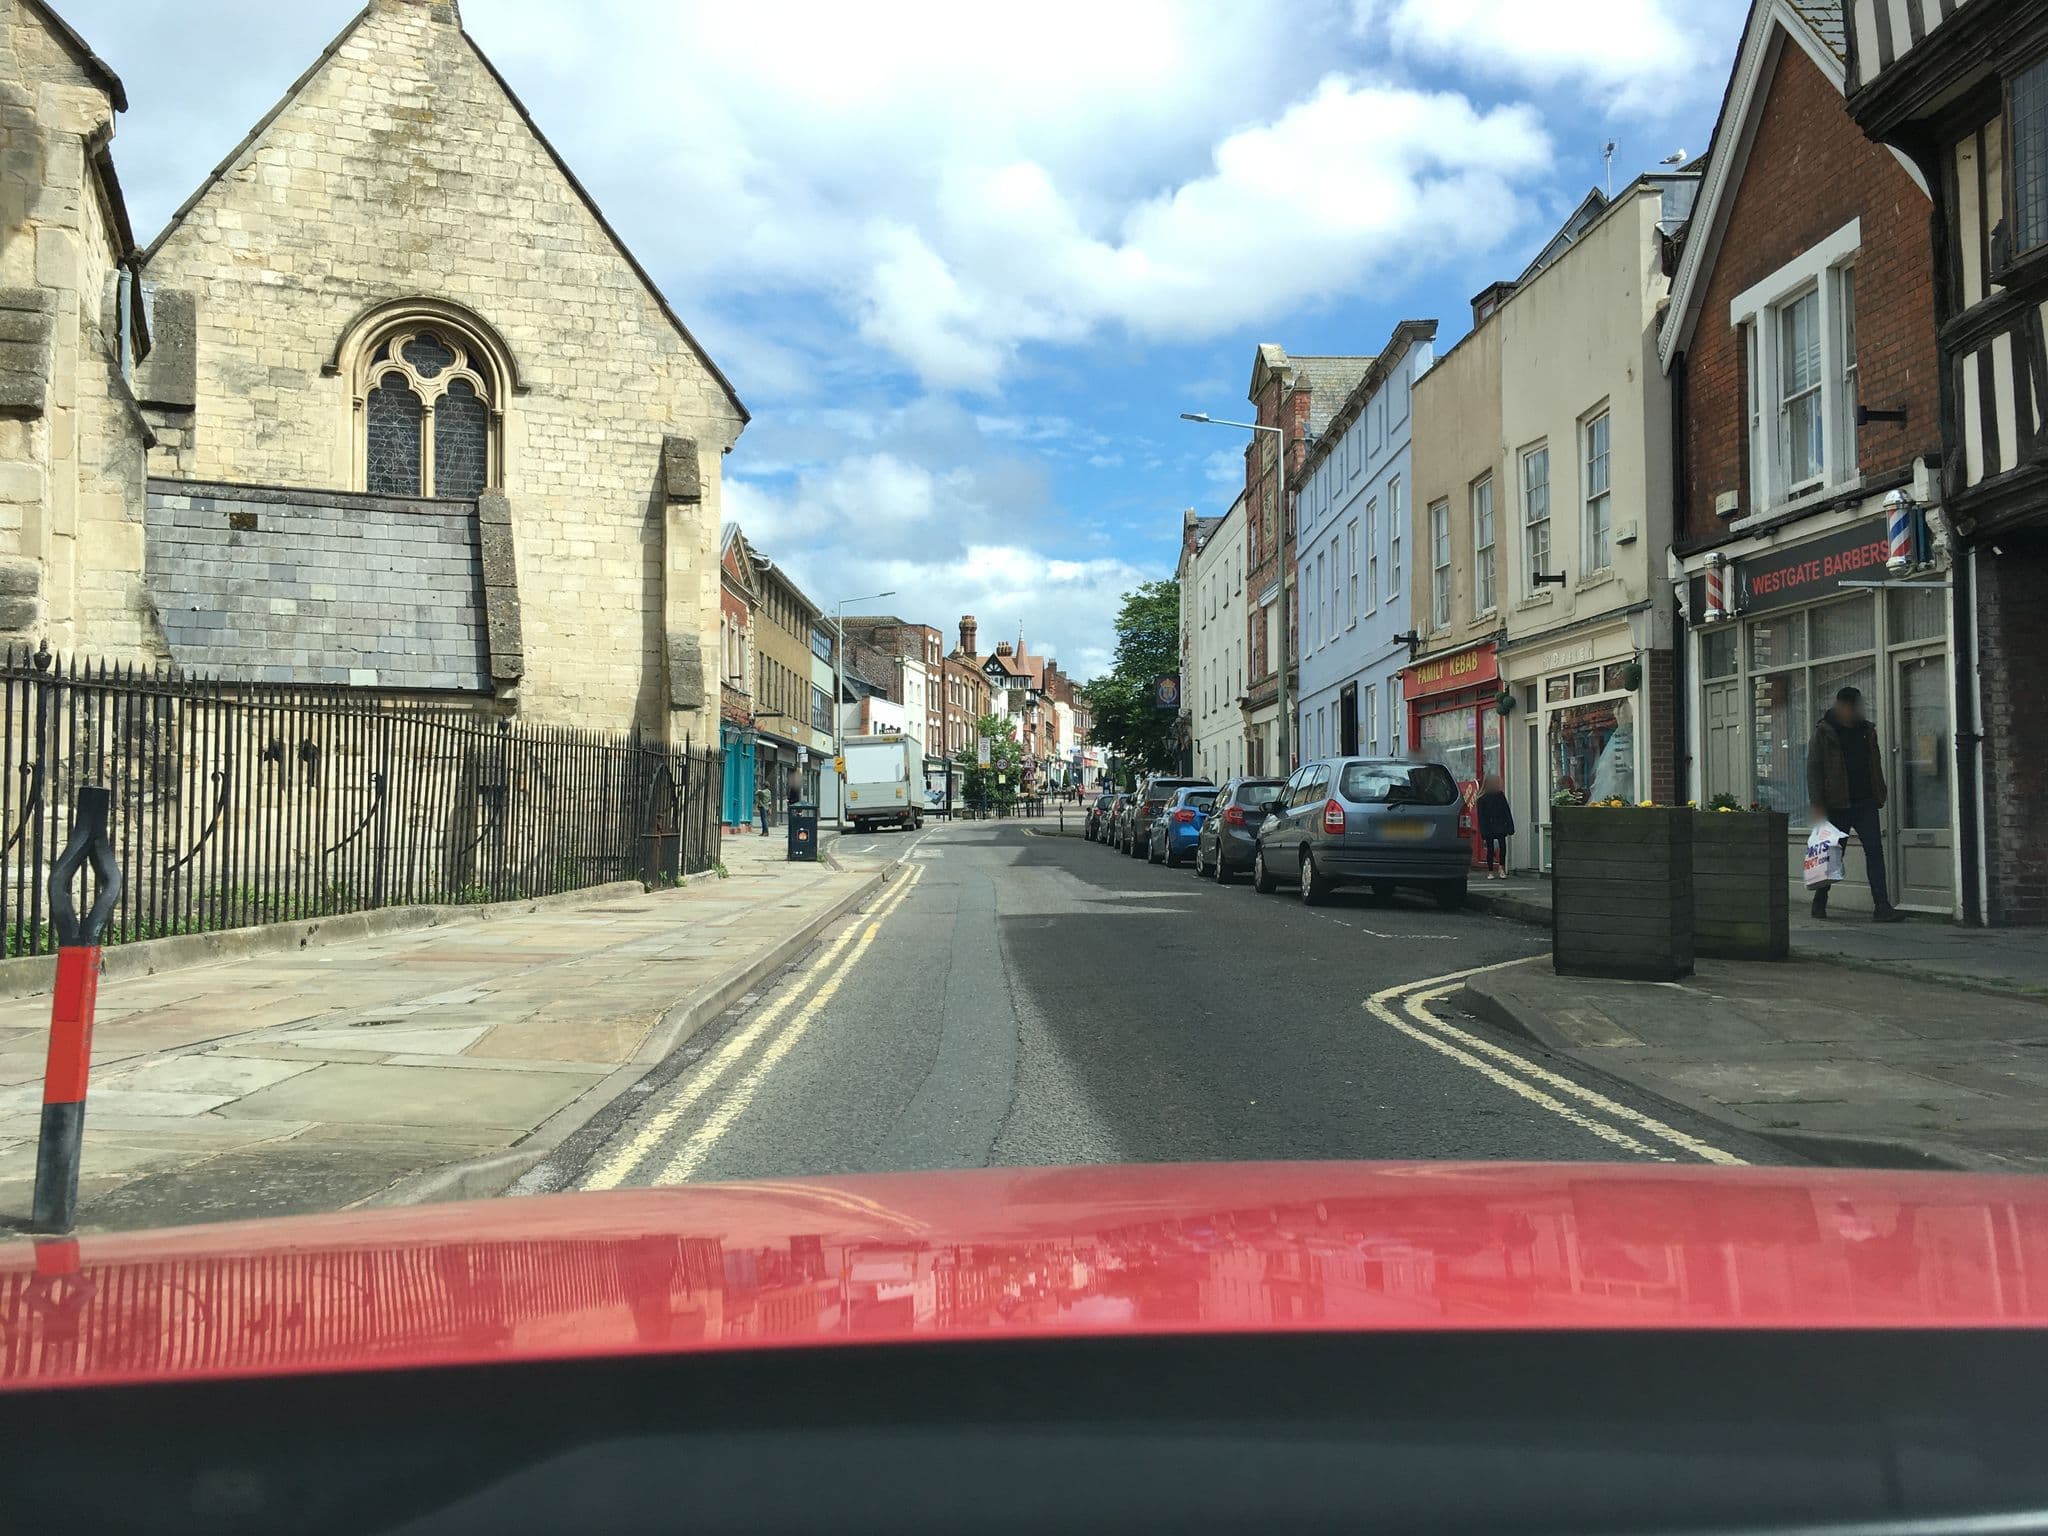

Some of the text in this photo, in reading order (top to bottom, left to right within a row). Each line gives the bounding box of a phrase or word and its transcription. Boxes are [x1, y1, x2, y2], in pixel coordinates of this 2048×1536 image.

[1752, 540, 1889, 596] WESTGATE BARBERS
[1417, 651, 1478, 685] FAMILY KEBAB
